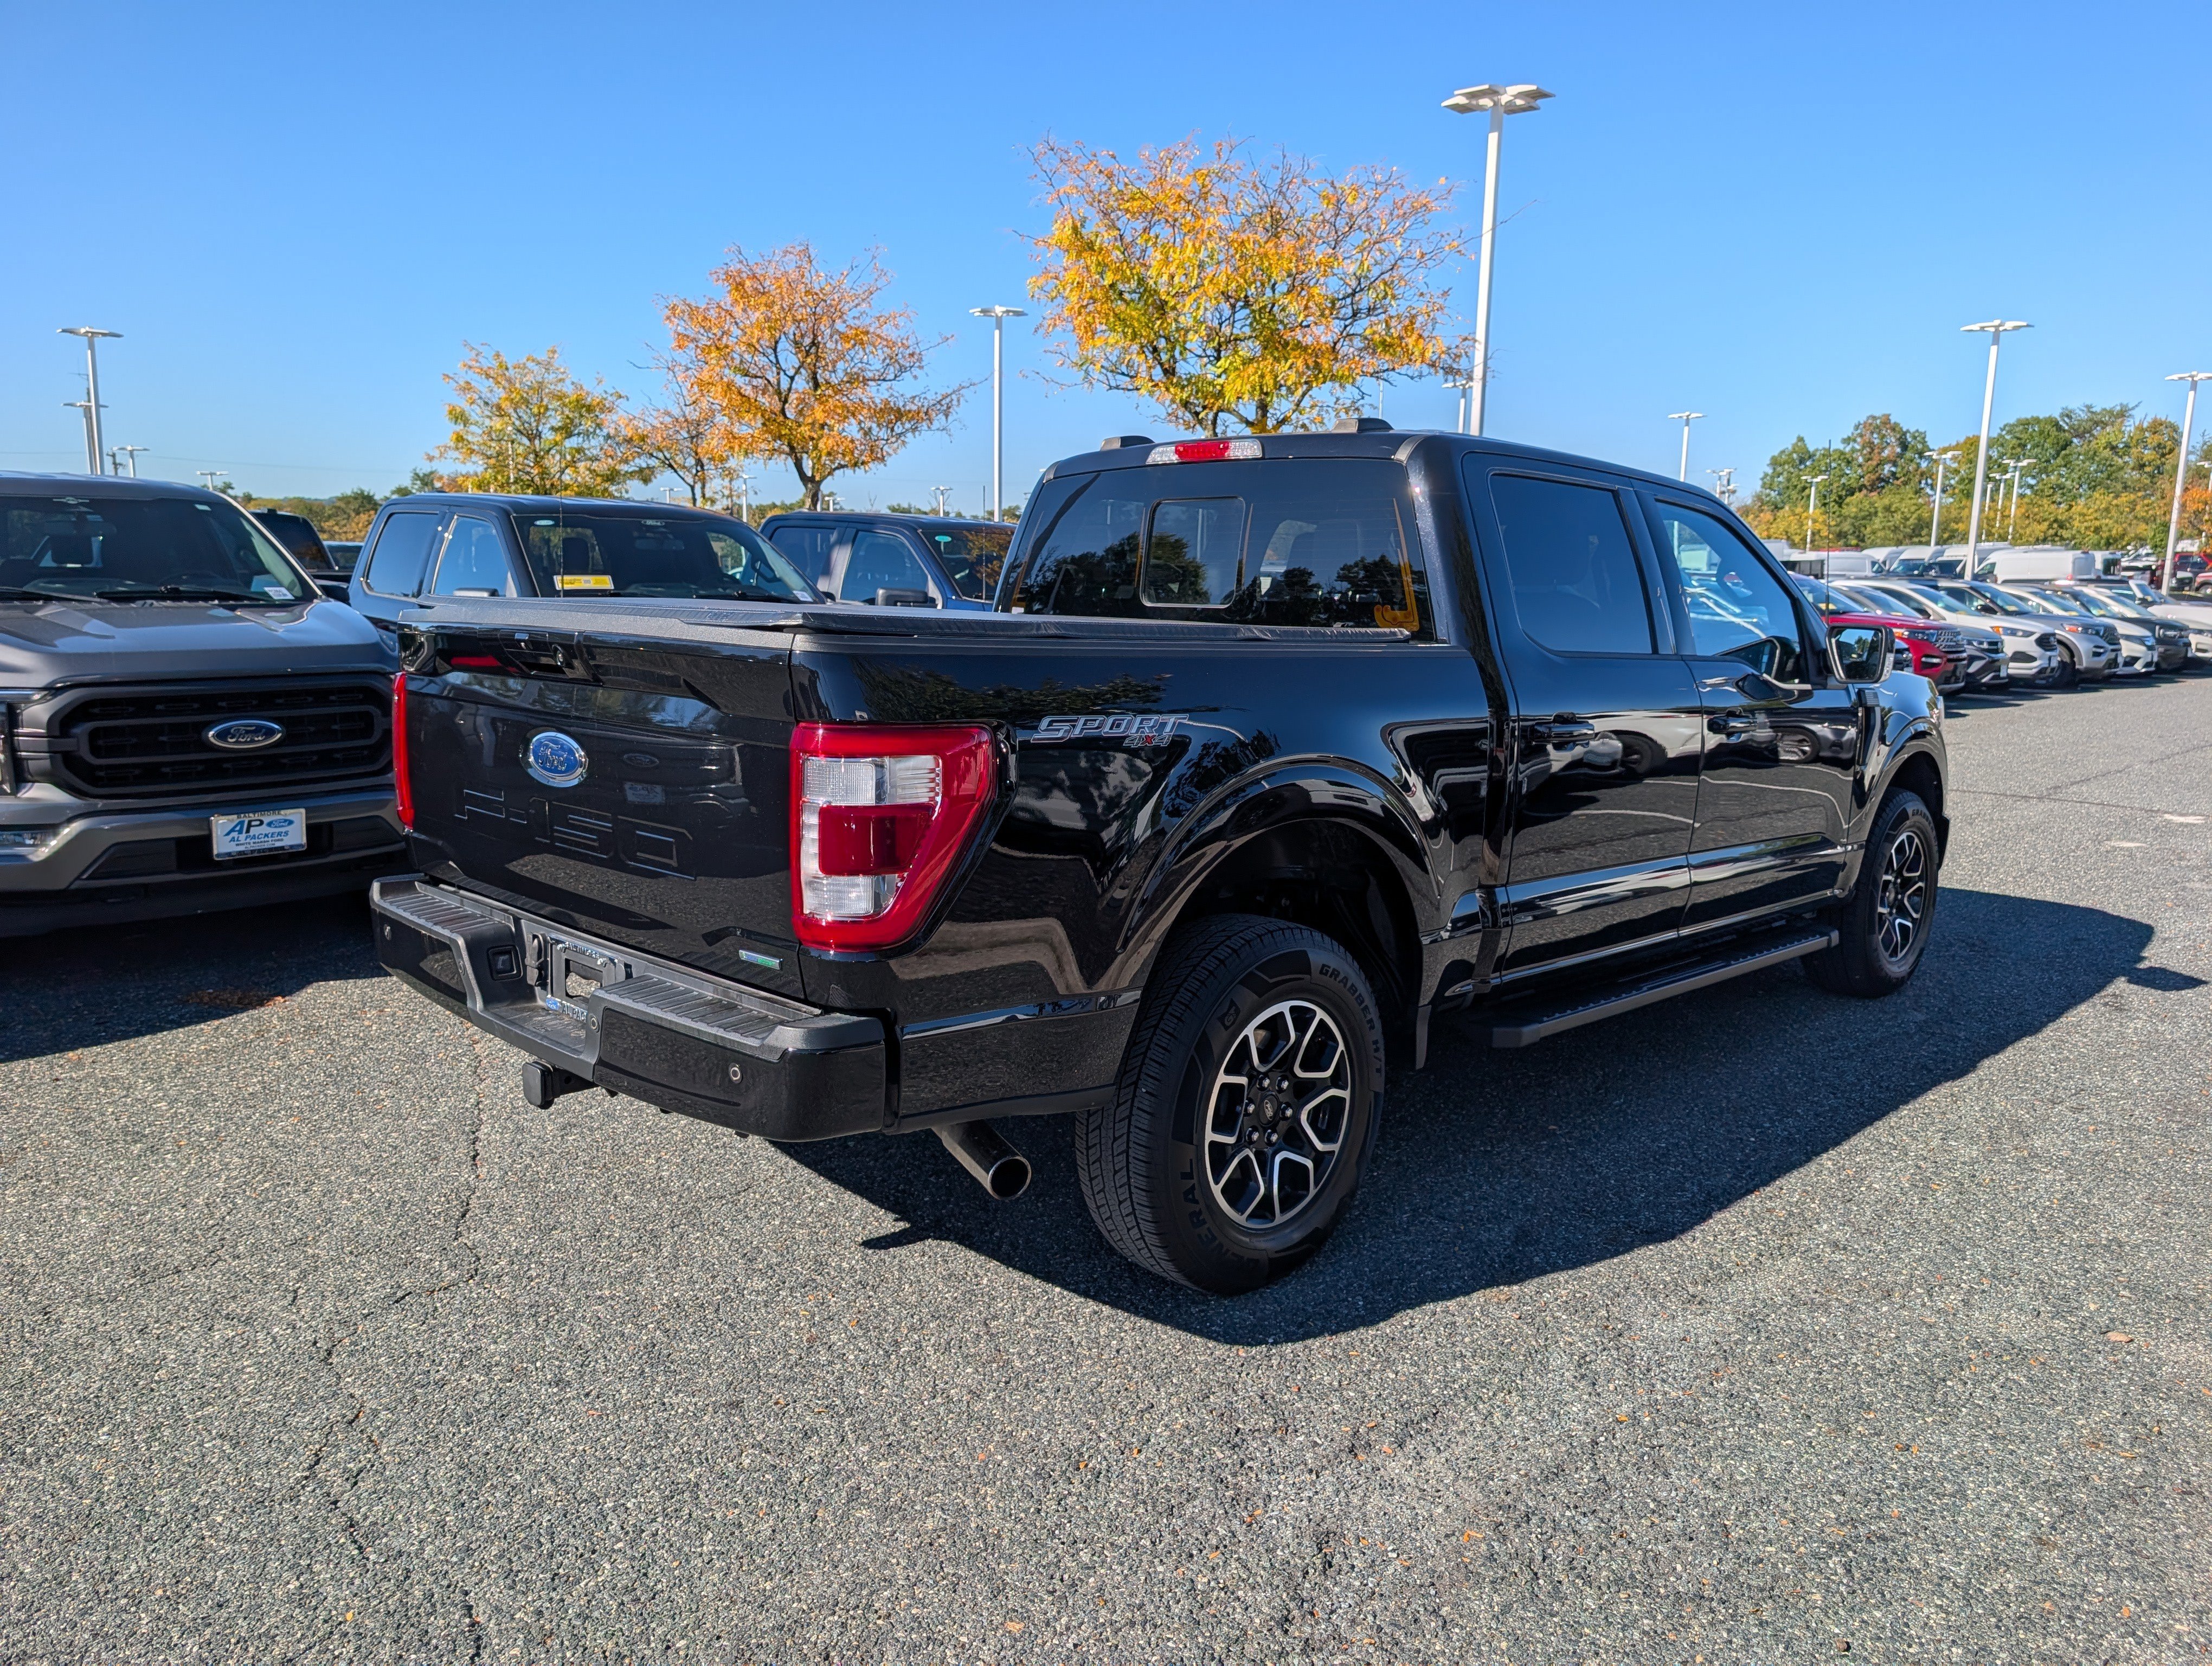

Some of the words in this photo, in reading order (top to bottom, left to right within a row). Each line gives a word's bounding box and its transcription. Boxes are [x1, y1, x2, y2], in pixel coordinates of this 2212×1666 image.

[227, 726, 266, 742] Ford
[1030, 714, 1189, 743] SPORT
[538, 741, 568, 771] Ford
[223, 818, 265, 837] AP
[237, 810, 282, 819] BALTIMORE
[244, 830, 290, 842] PACKERS
[454, 789, 697, 881] F-150
[1319, 963, 1375, 1031] GRABBER
[1180, 1158, 1260, 1270] NERAL
